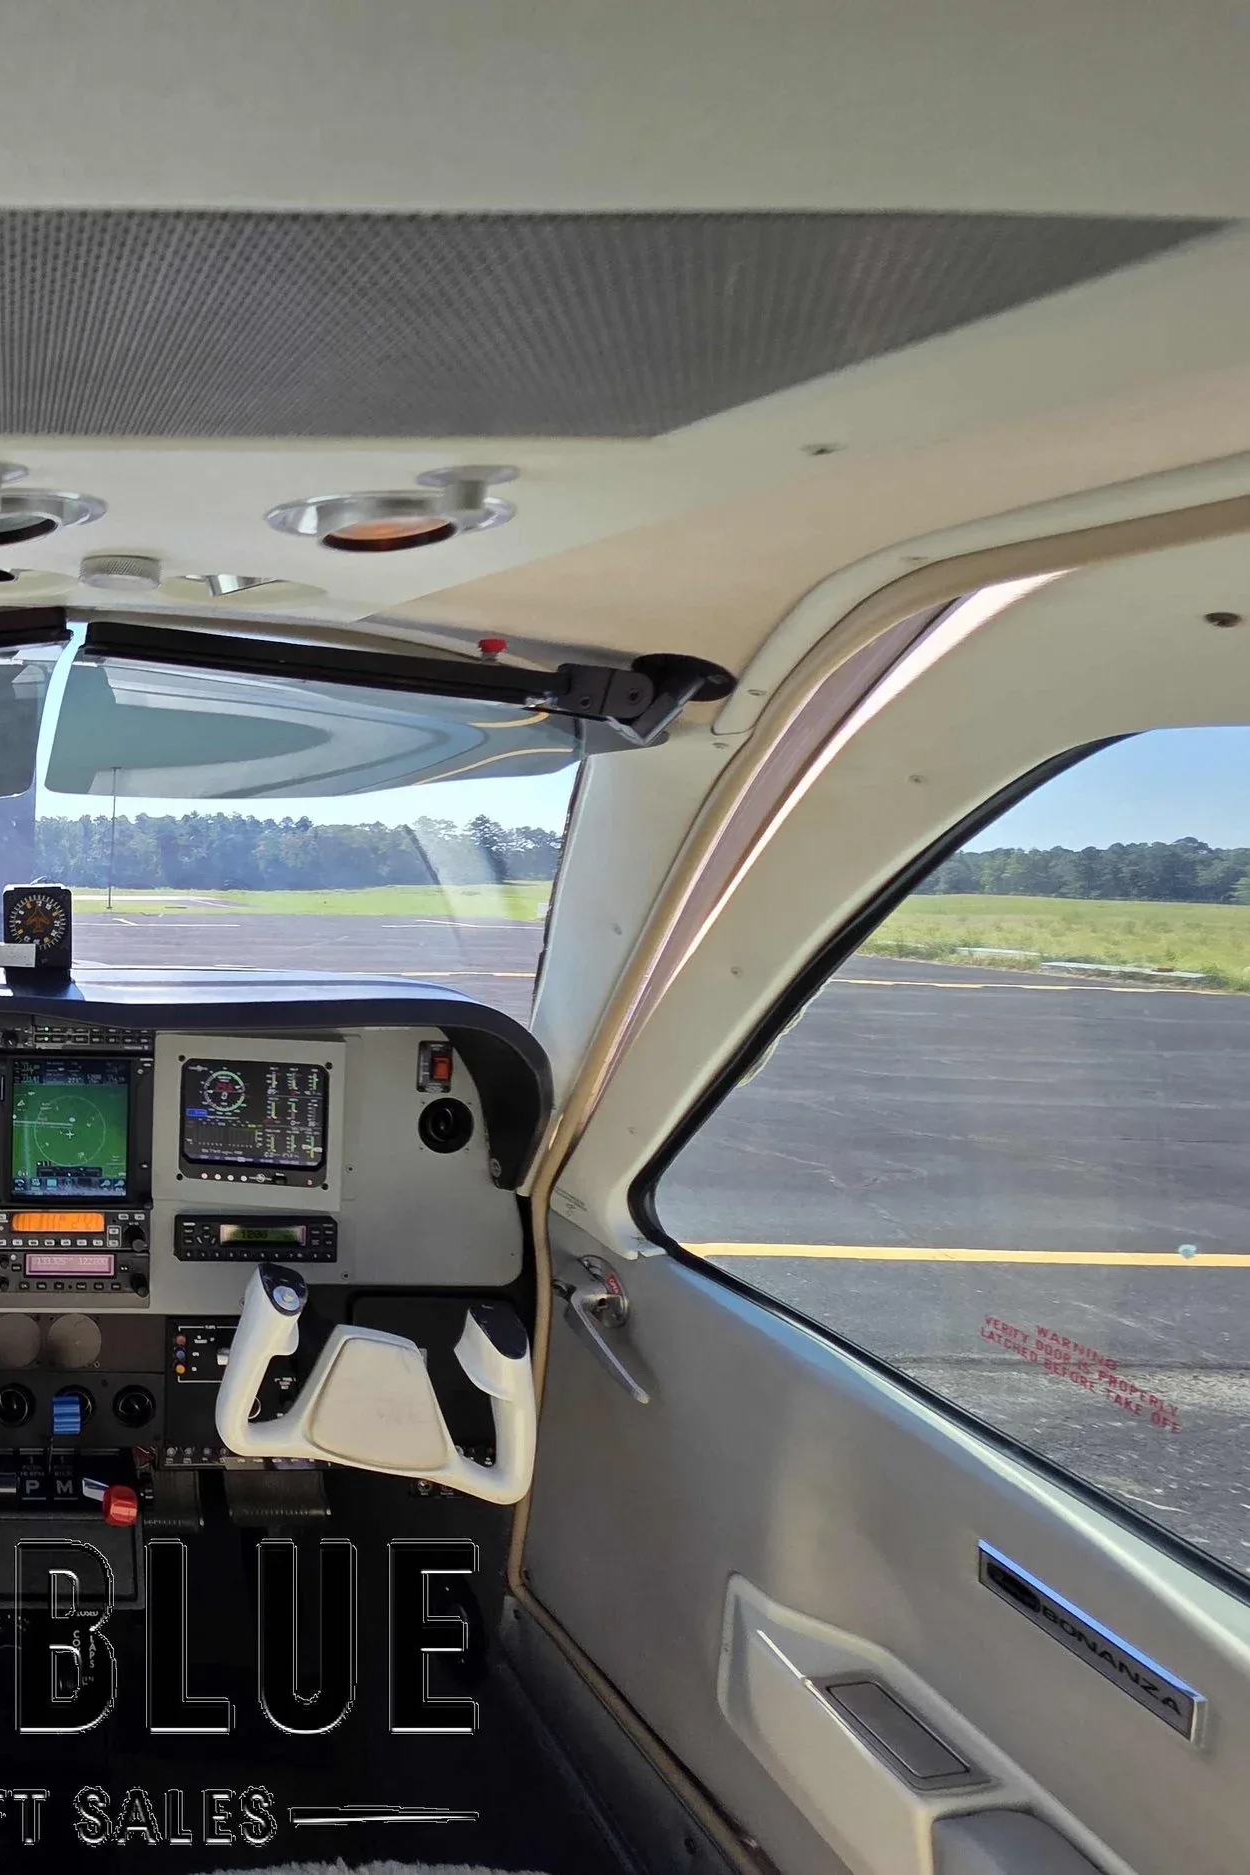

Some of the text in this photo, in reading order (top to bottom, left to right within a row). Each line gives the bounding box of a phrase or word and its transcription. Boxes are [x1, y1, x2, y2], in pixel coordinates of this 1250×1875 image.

[979, 1326, 1182, 1435] LATCHED BEFORE TAKE OFF
[984, 1314, 1030, 1344] VERIFY
[1035, 1339, 1072, 1363] DOOR
[1096, 1370, 1180, 1418] PROPERLY
[1035, 1325, 1118, 1371] WARNING
[25, 1479, 40, 1494] P
[56, 1479, 73, 1494] M
[1042, 1606, 1183, 1716] BONANZA
